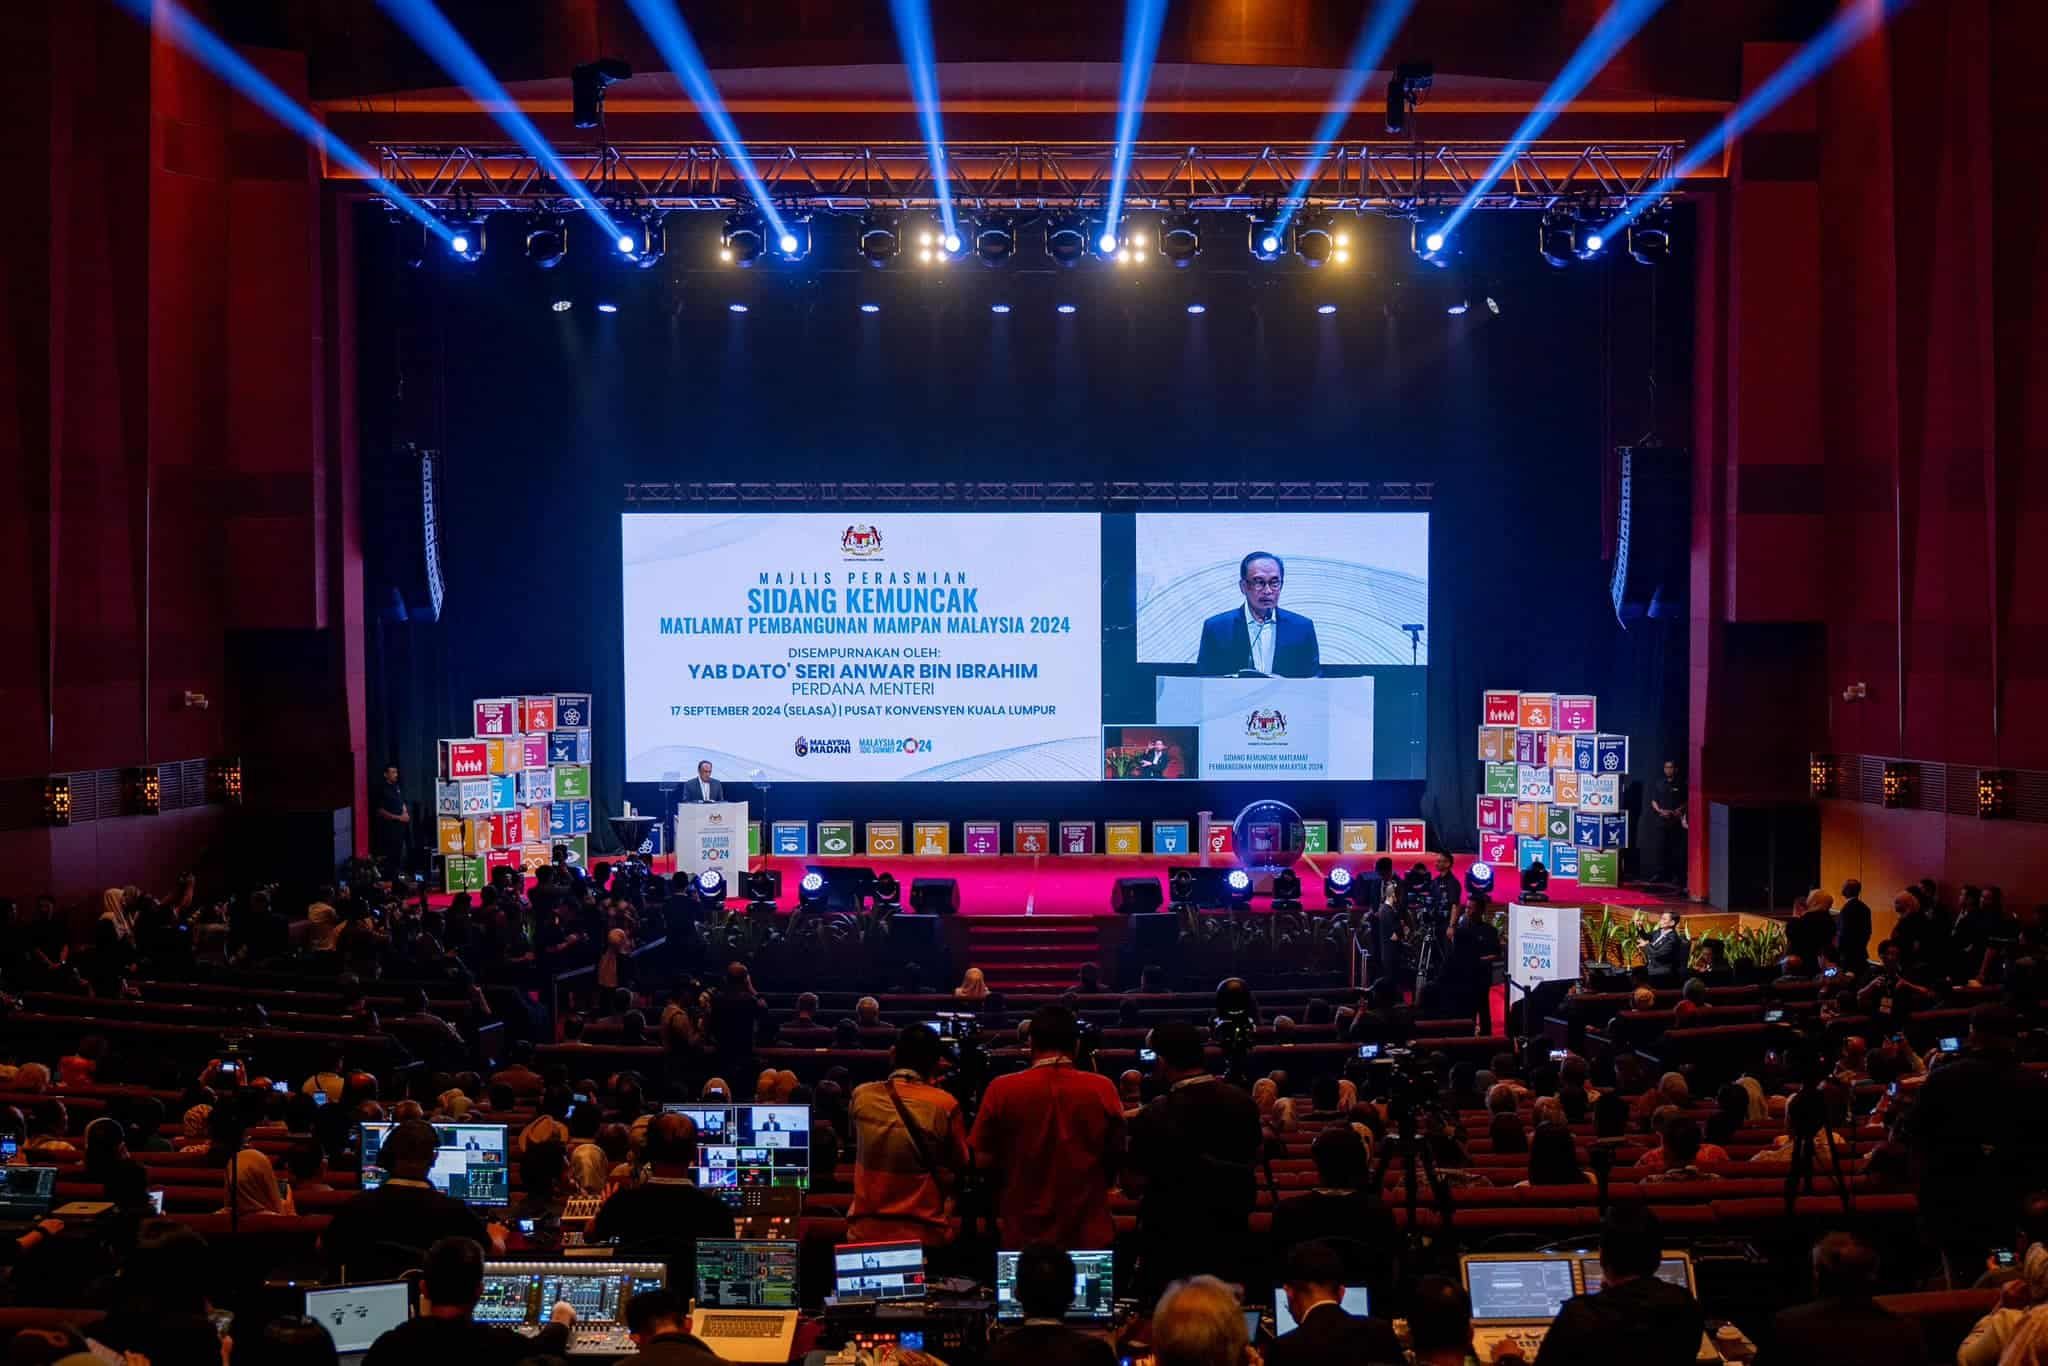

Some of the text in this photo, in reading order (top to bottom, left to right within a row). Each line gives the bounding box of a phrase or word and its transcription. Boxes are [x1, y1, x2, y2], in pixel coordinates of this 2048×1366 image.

[759, 571, 966, 585] MAJLIS PERASMIAN
[747, 587, 979, 614] SIDANG KEMUNCAK
[659, 616, 1072, 635] MATLAMAT PEMBANGUNAN MAMPAN MALAYSIA 2024
[788, 647, 941, 659] DISEMPURNAKAN OLEH:
[687, 662, 1039, 680] YAB DATO' SERI ANWAR BIN IBRAHIM
[791, 682, 935, 696] PERDANA MENTERI
[670, 705, 682, 717] 17
[683, 705, 750, 717] SEPTEMBER
[751, 705, 782, 717] 2024
[783, 703, 838, 718] (SELASA)
[844, 705, 883, 716] PUSAT
[885, 705, 966, 716] KONVENSYEN
[967, 705, 1006, 716] KUALA
[1008, 705, 1057, 716] LUMPUR
[809, 738, 850, 746] MALAYSIA
[858, 738, 895, 746] MALAYSIA
[809, 745, 851, 754] MADANI
[1521, 783, 1551, 796] 2024
[463, 798, 490, 811] 2024
[1583, 793, 1613, 806] 2024
[702, 848, 729, 861] 2024
[1522, 955, 1551, 969] 2024
